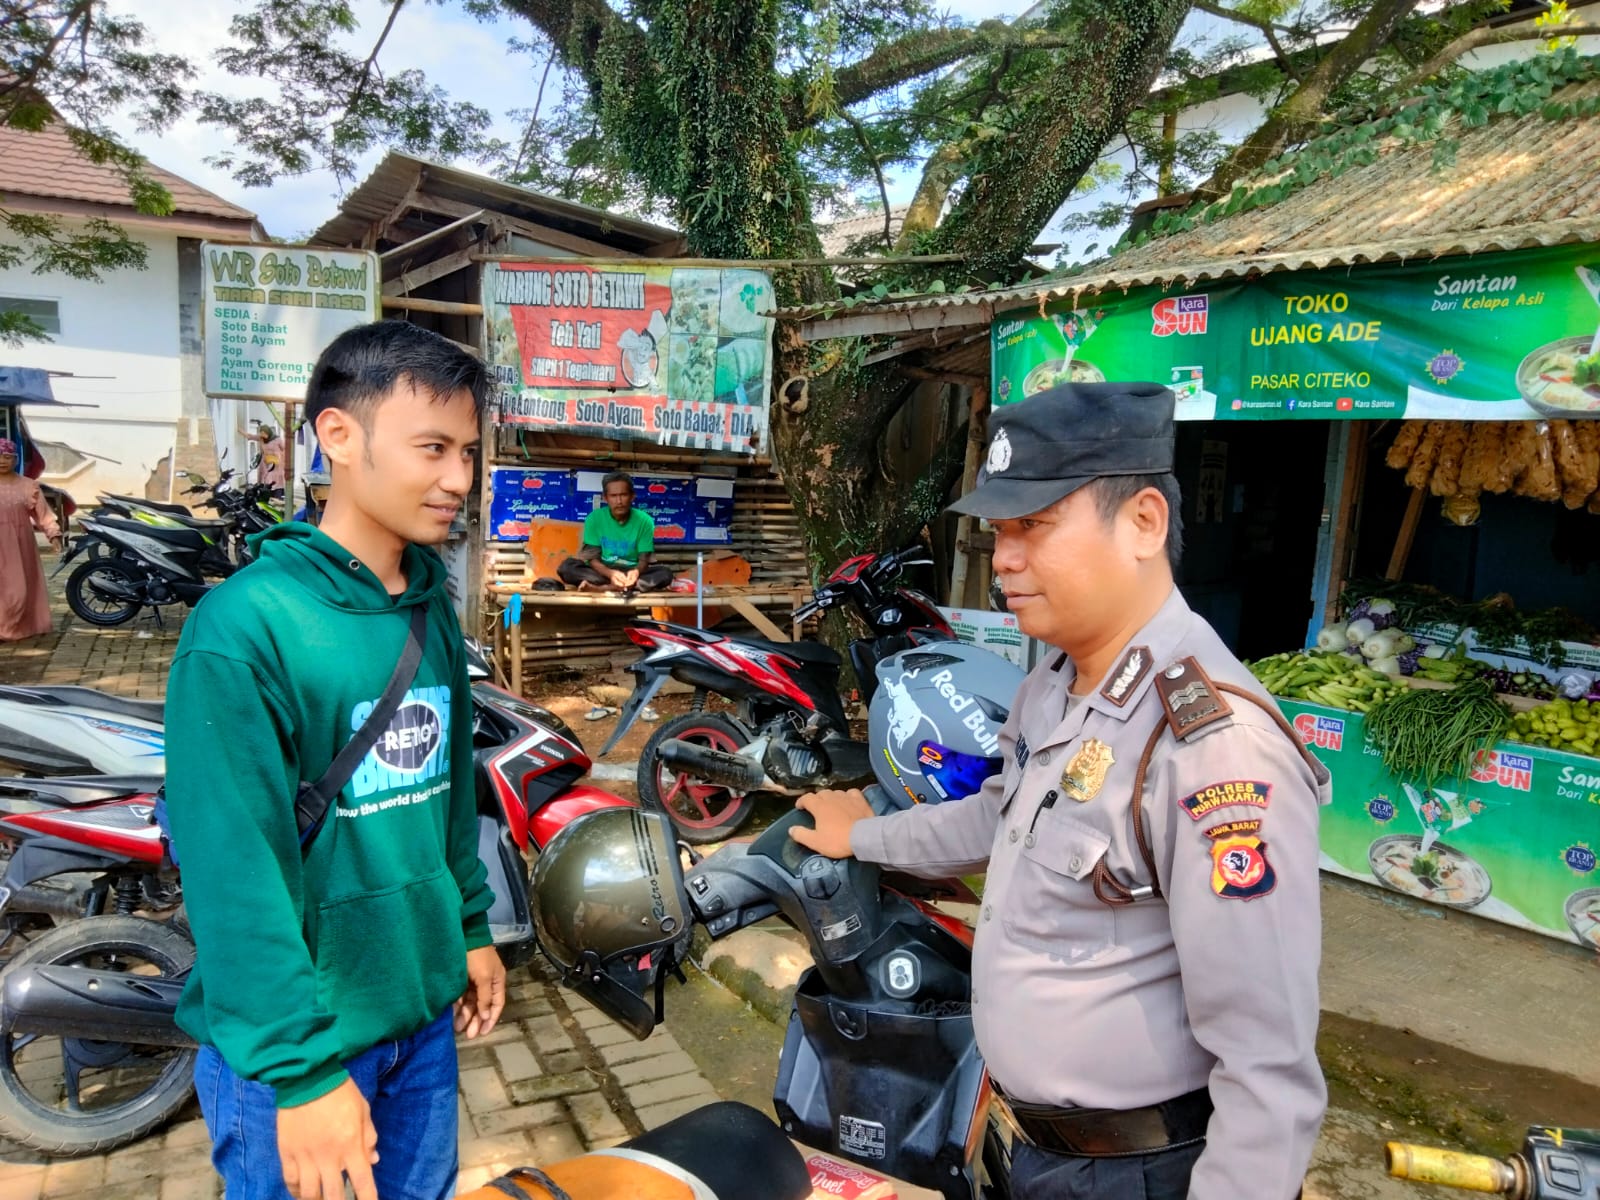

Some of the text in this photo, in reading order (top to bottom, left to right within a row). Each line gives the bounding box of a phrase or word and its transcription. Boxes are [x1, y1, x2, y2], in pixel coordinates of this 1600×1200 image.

[259, 253, 301, 286] Soto
[306, 255, 367, 291] Betawi
[495, 269, 646, 310] WARUNG SOTO BETAWI
[1433, 275, 1518, 297] Santan
[1180, 298, 1205, 311] kara
[1283, 292, 1350, 315] TOKO
[1431, 292, 1545, 313] Dari Kelapa Asli
[214, 308, 250, 319] SEDIA
[1152, 298, 1207, 336] SUN
[221, 321, 288, 334] Soto Babat
[550, 319, 574, 348] Teh
[997, 320, 1024, 339] Santan
[1250, 321, 1382, 346] UJANG ADE
[221, 333, 285, 347] Soto Ayam
[221, 345, 243, 358] Sop
[221, 357, 253, 370] Ayam
[257, 360, 303, 374] Goreng
[531, 357, 557, 378] SMPN
[221, 381, 243, 391] DLL
[251, 371, 275, 382] Dan
[1251, 372, 1371, 390] PASAR CITEKO
[576, 400, 605, 424] Soto
[1298, 400, 1333, 408] Kara Santan
[1355, 400, 1395, 408] Kara Santan
[654, 405, 681, 430] Soto
[930, 669, 975, 713] Red
[1293, 713, 1342, 751] SUN
[1319, 718, 1341, 731] kara
[1471, 749, 1531, 791] SUN
[1503, 754, 1529, 768] kara
[1196, 783, 1254, 803] POLRES
[1557, 785, 1584, 800] Dari
[360, 803, 378, 815] the
[379, 794, 409, 810] world
[1191, 793, 1265, 817] PURWAKARTA
[1373, 801, 1392, 813] TOP
[1231, 821, 1259, 831] BARAT
[1570, 850, 1594, 861] TOP
[650, 879, 665, 921] Retro
[811, 1171, 846, 1194] Duet
